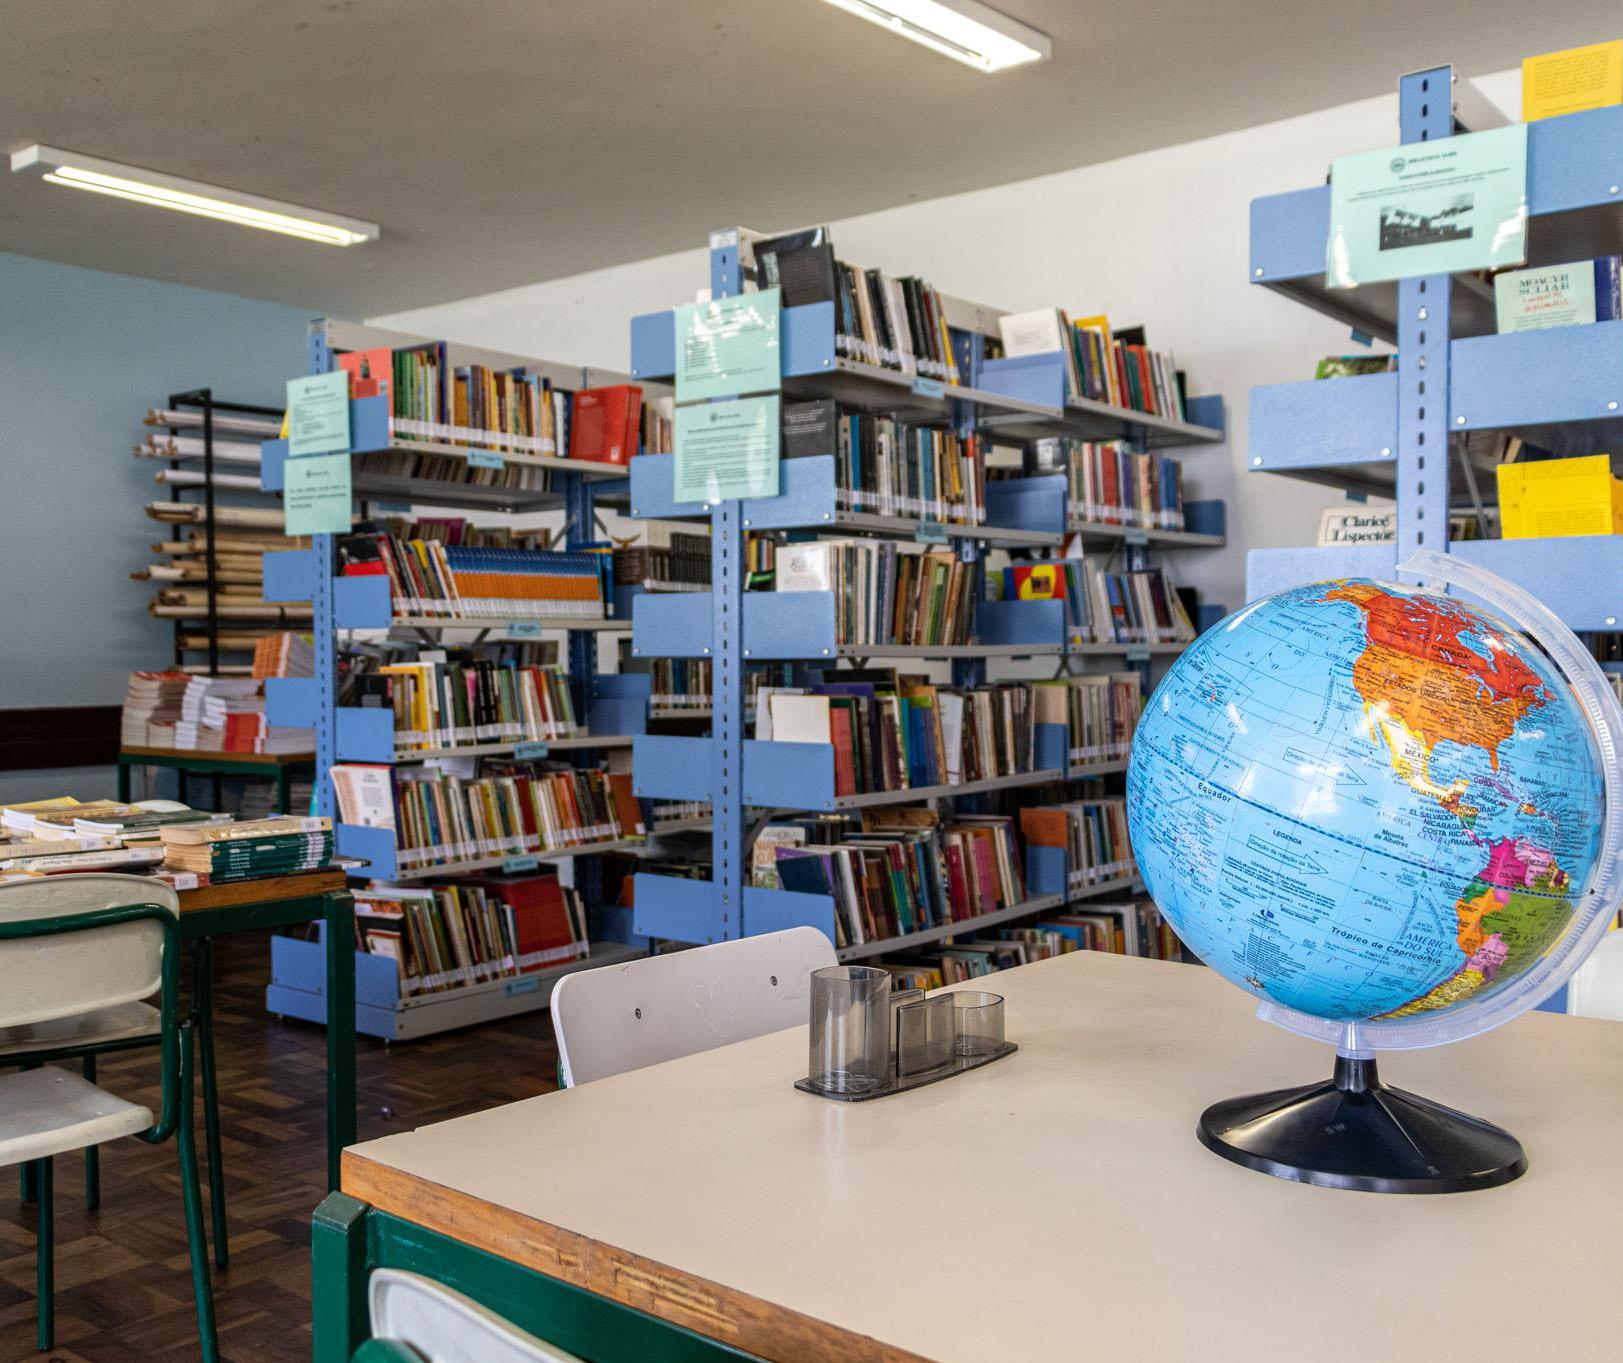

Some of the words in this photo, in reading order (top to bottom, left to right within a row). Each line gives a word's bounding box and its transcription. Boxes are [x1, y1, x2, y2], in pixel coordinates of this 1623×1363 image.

[1342, 515, 1389, 528] Clarice
[1332, 529, 1395, 544] Lispector
[1197, 782, 1232, 803] Equador
[1409, 807, 1419, 817] EL
[1420, 810, 1458, 822] SALVADOR
[1272, 828, 1302, 846] LEGENDA
[1422, 826, 1448, 838] COSTA
[1331, 926, 1369, 945] Trópico
[1371, 941, 1384, 950] de
[1404, 941, 1422, 952] DO
